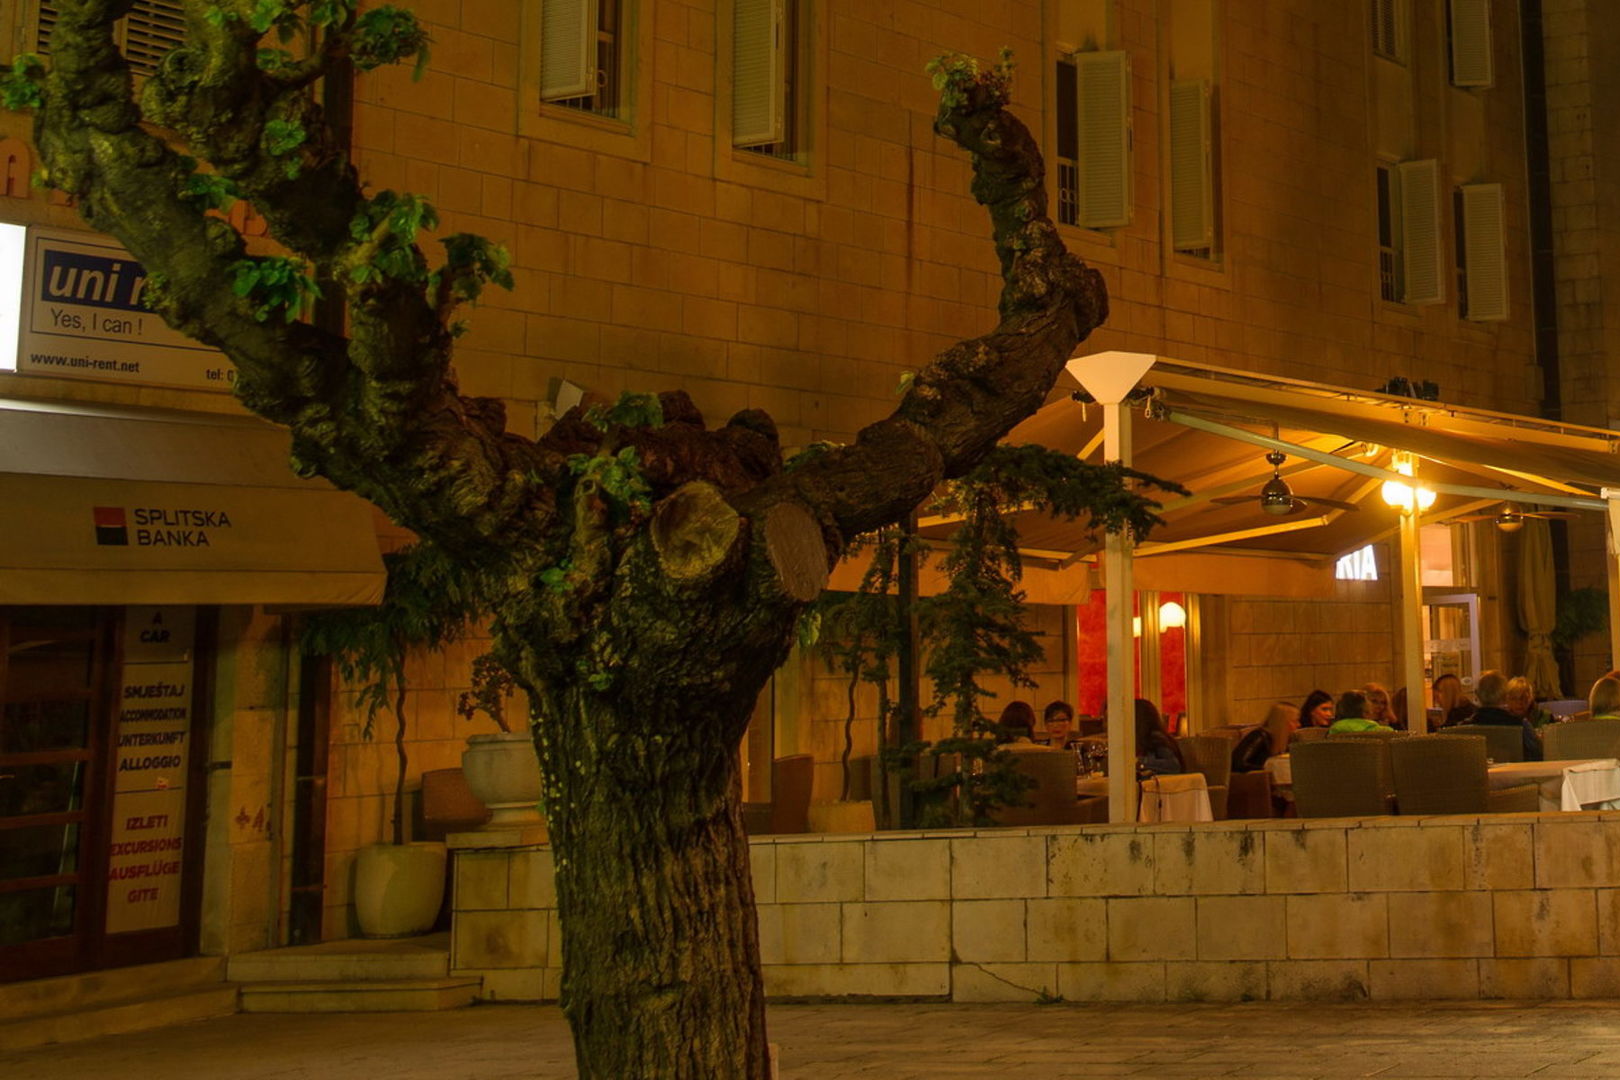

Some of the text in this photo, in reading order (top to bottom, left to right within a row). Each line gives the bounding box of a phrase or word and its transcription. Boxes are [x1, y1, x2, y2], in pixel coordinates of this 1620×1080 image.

[48, 263, 121, 303] uni
[51, 308, 86, 333] Yes,
[92, 313, 97, 331] I
[102, 318, 132, 335] can
[30, 352, 140, 374] www.uni-rent.net
[206, 368, 224, 381] tel:
[134, 508, 232, 529] SPLITSKA
[137, 529, 211, 547] BANKA
[139, 629, 171, 644] CAR
[124, 681, 185, 699] SMJEŠTAJ
[119, 707, 187, 724] ACCOMMODATION
[117, 730, 186, 748] UNTERKUNFT
[119, 754, 181, 772] ALLOGGIO
[125, 814, 168, 831] IZLETI
[110, 836, 182, 857] EXCURSIONS
[108, 859, 180, 882] AUSFLÜGE
[127, 886, 160, 904] GITE
